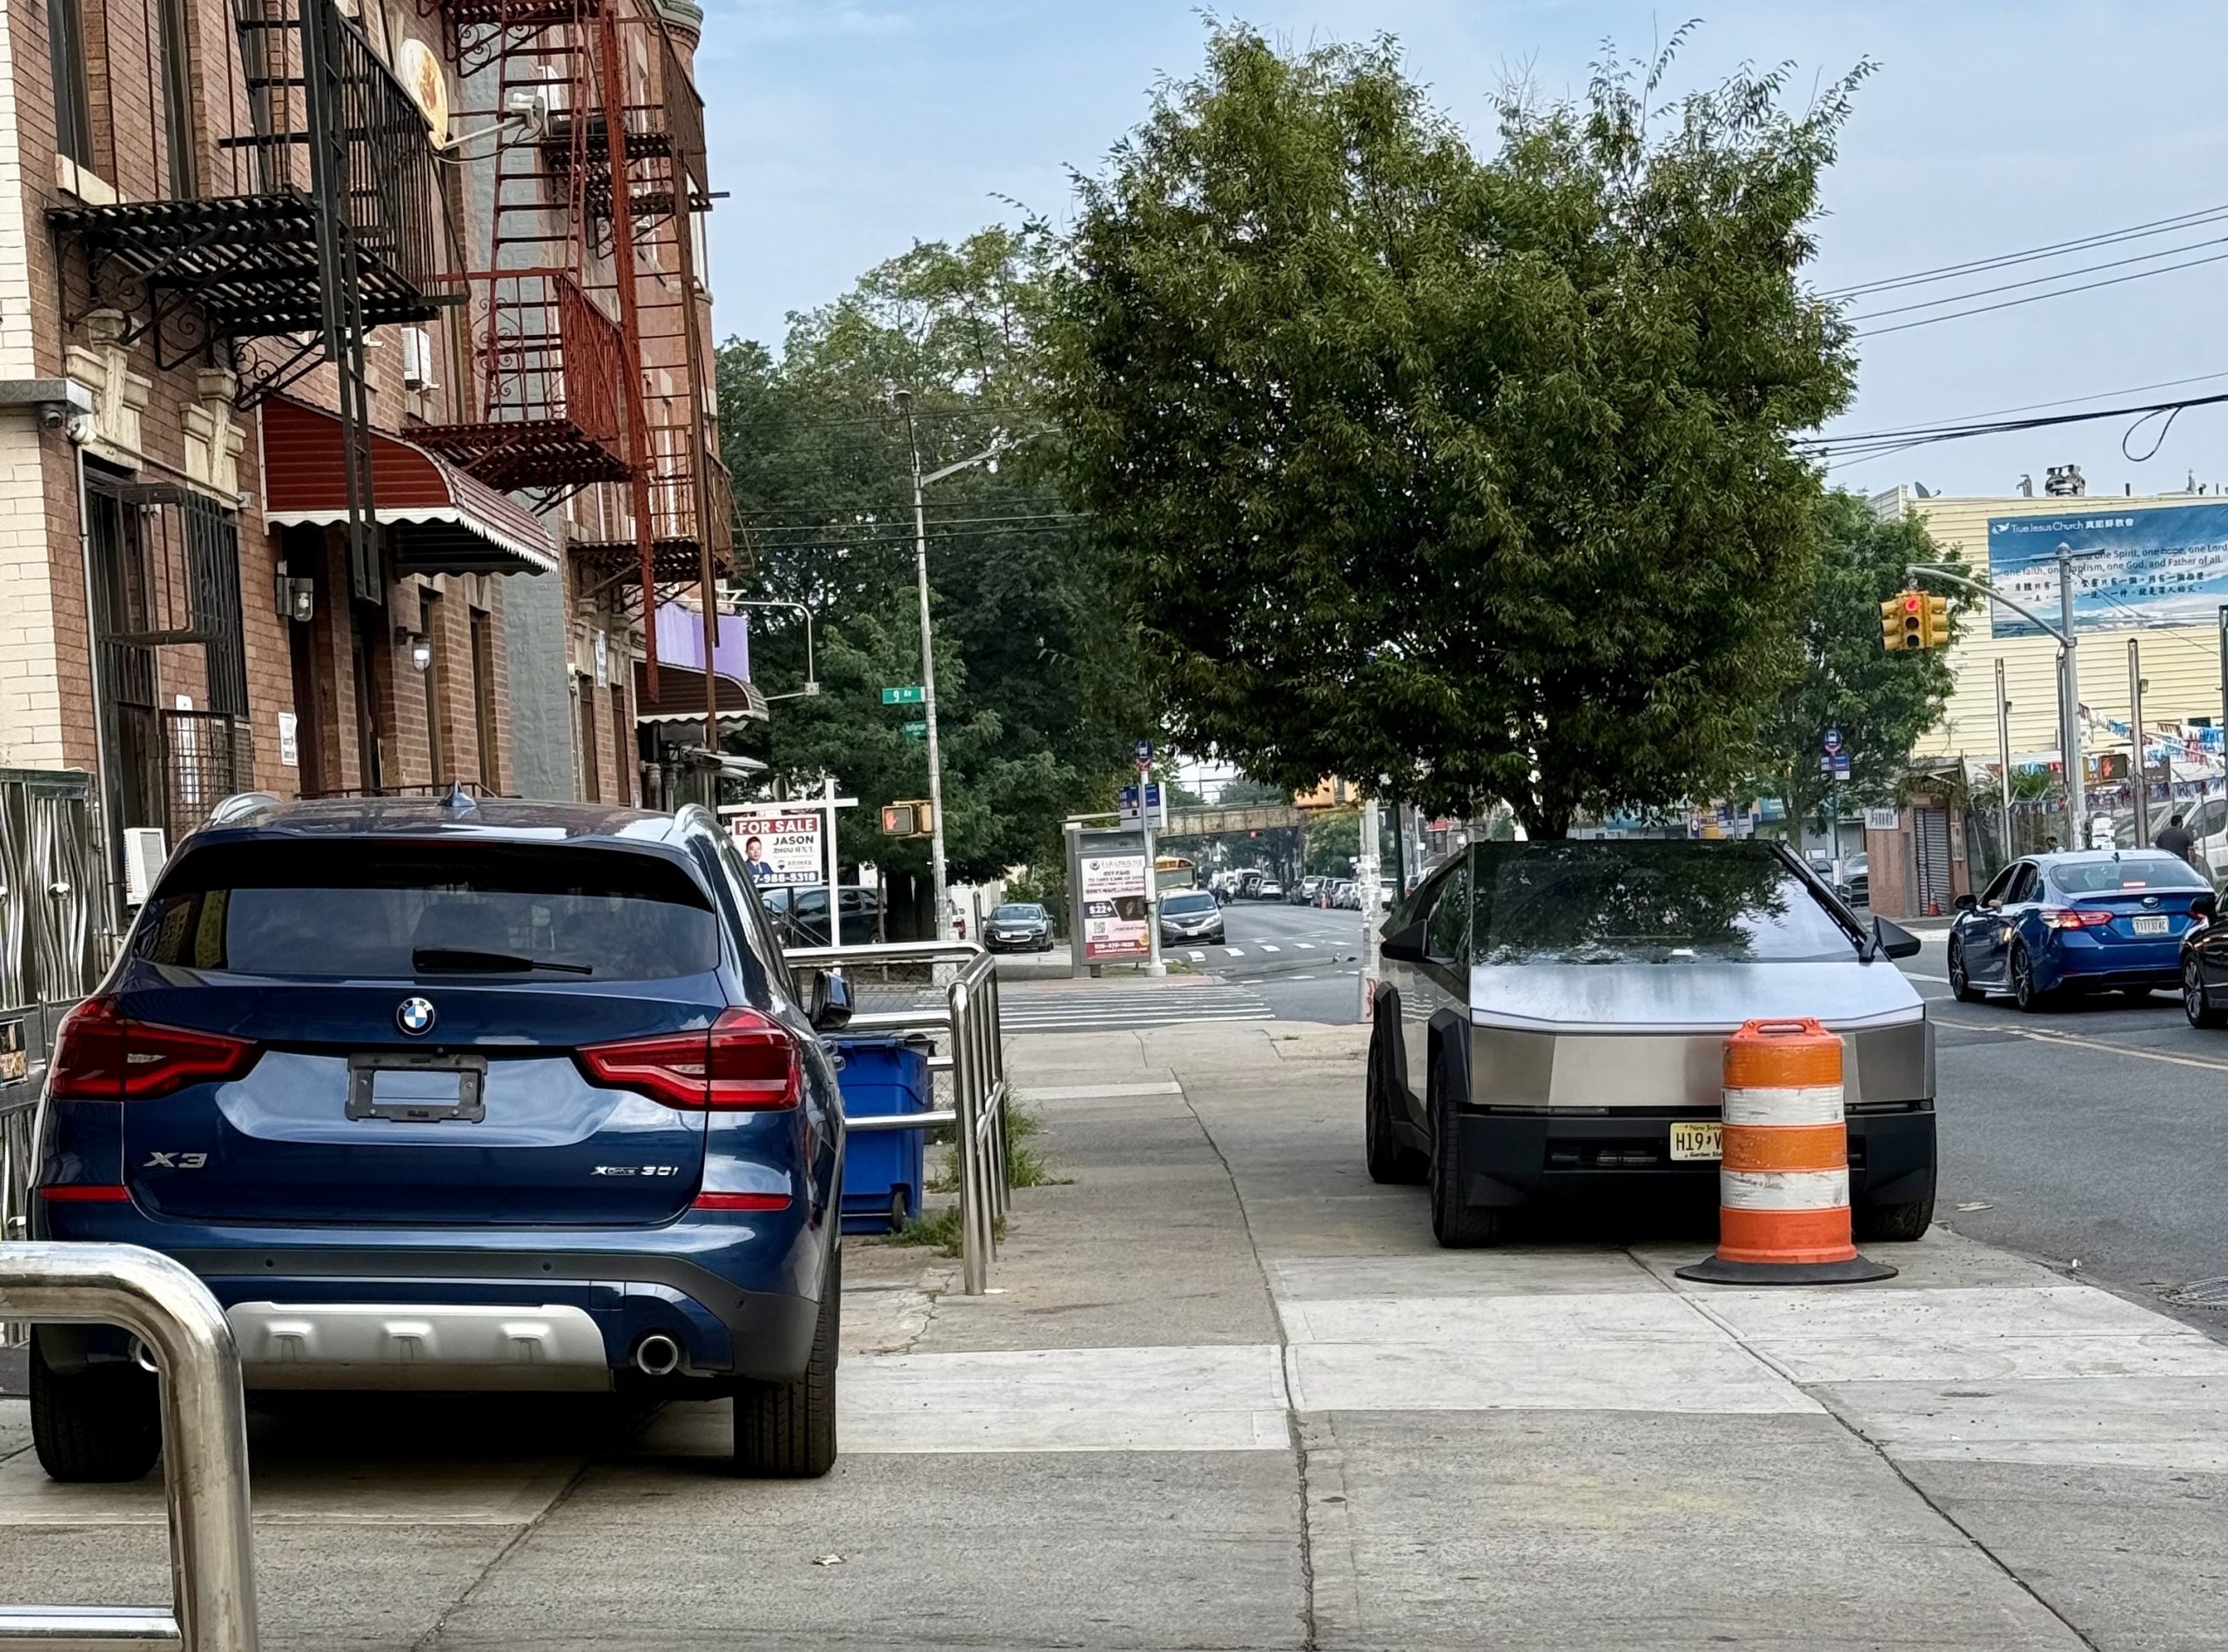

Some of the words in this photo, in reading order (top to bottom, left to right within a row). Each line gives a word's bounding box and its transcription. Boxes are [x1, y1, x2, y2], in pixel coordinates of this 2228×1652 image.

[2010, 524, 2029, 533] True
[2030, 523, 2052, 532] Jesus
[2052, 520, 2084, 531] Church
[2142, 548, 2160, 557] one
[2207, 543, 2228, 553] Lord
[2004, 568, 2021, 577] one
[2068, 562, 2105, 576] aptism,
[2107, 562, 2124, 571] one
[2126, 561, 2147, 572] God,
[2149, 559, 2166, 568] and
[2168, 557, 2197, 567] Father
[2198, 555, 2207, 565] of
[893, 690, 900, 702] 9
[903, 688, 912, 697] Av
[739, 821, 770, 835] FOR
[775, 819, 814, 833] SALE
[773, 836, 814, 846] JASON
[143, 1151, 208, 1169] X3
